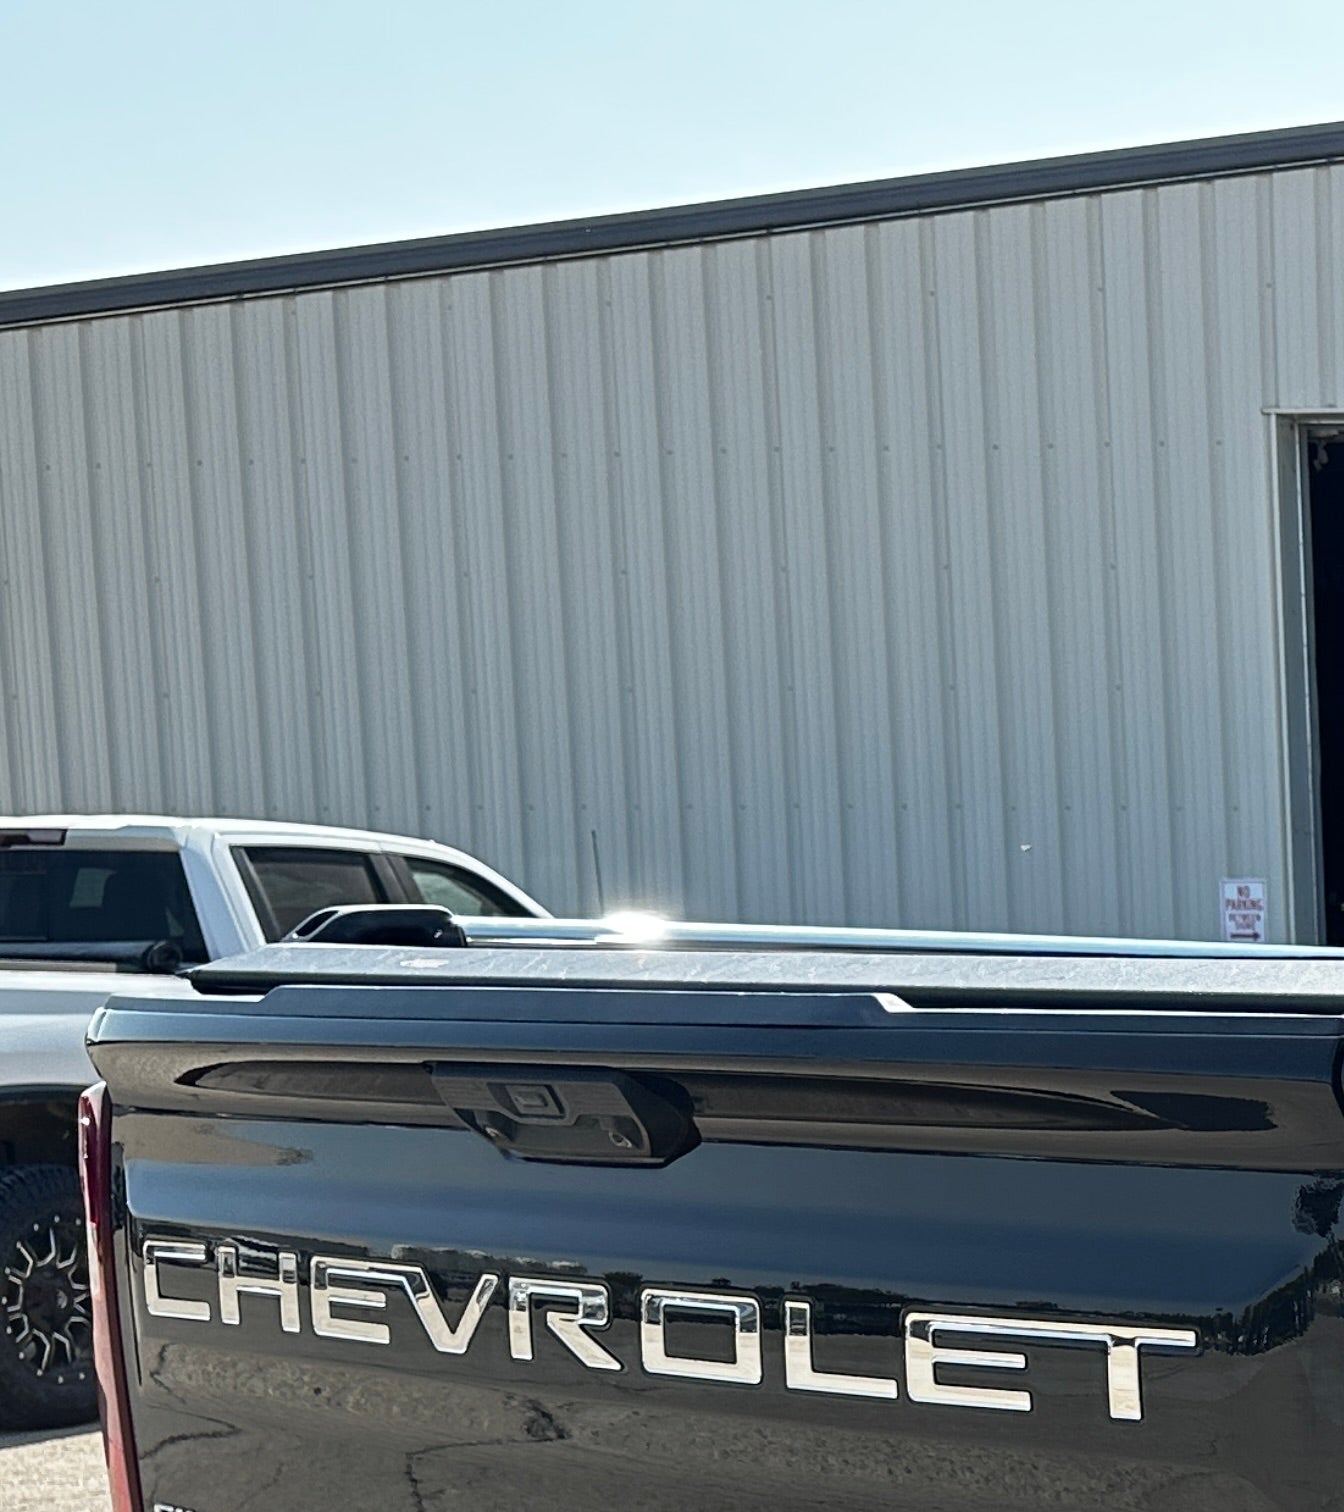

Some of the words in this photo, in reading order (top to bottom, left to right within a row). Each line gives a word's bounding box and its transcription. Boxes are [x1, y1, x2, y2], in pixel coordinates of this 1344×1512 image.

[1237, 885, 1250, 898] NO
[1225, 898, 1264, 911] PARKING
[143, 1239, 1198, 1421] CHEVROLET
